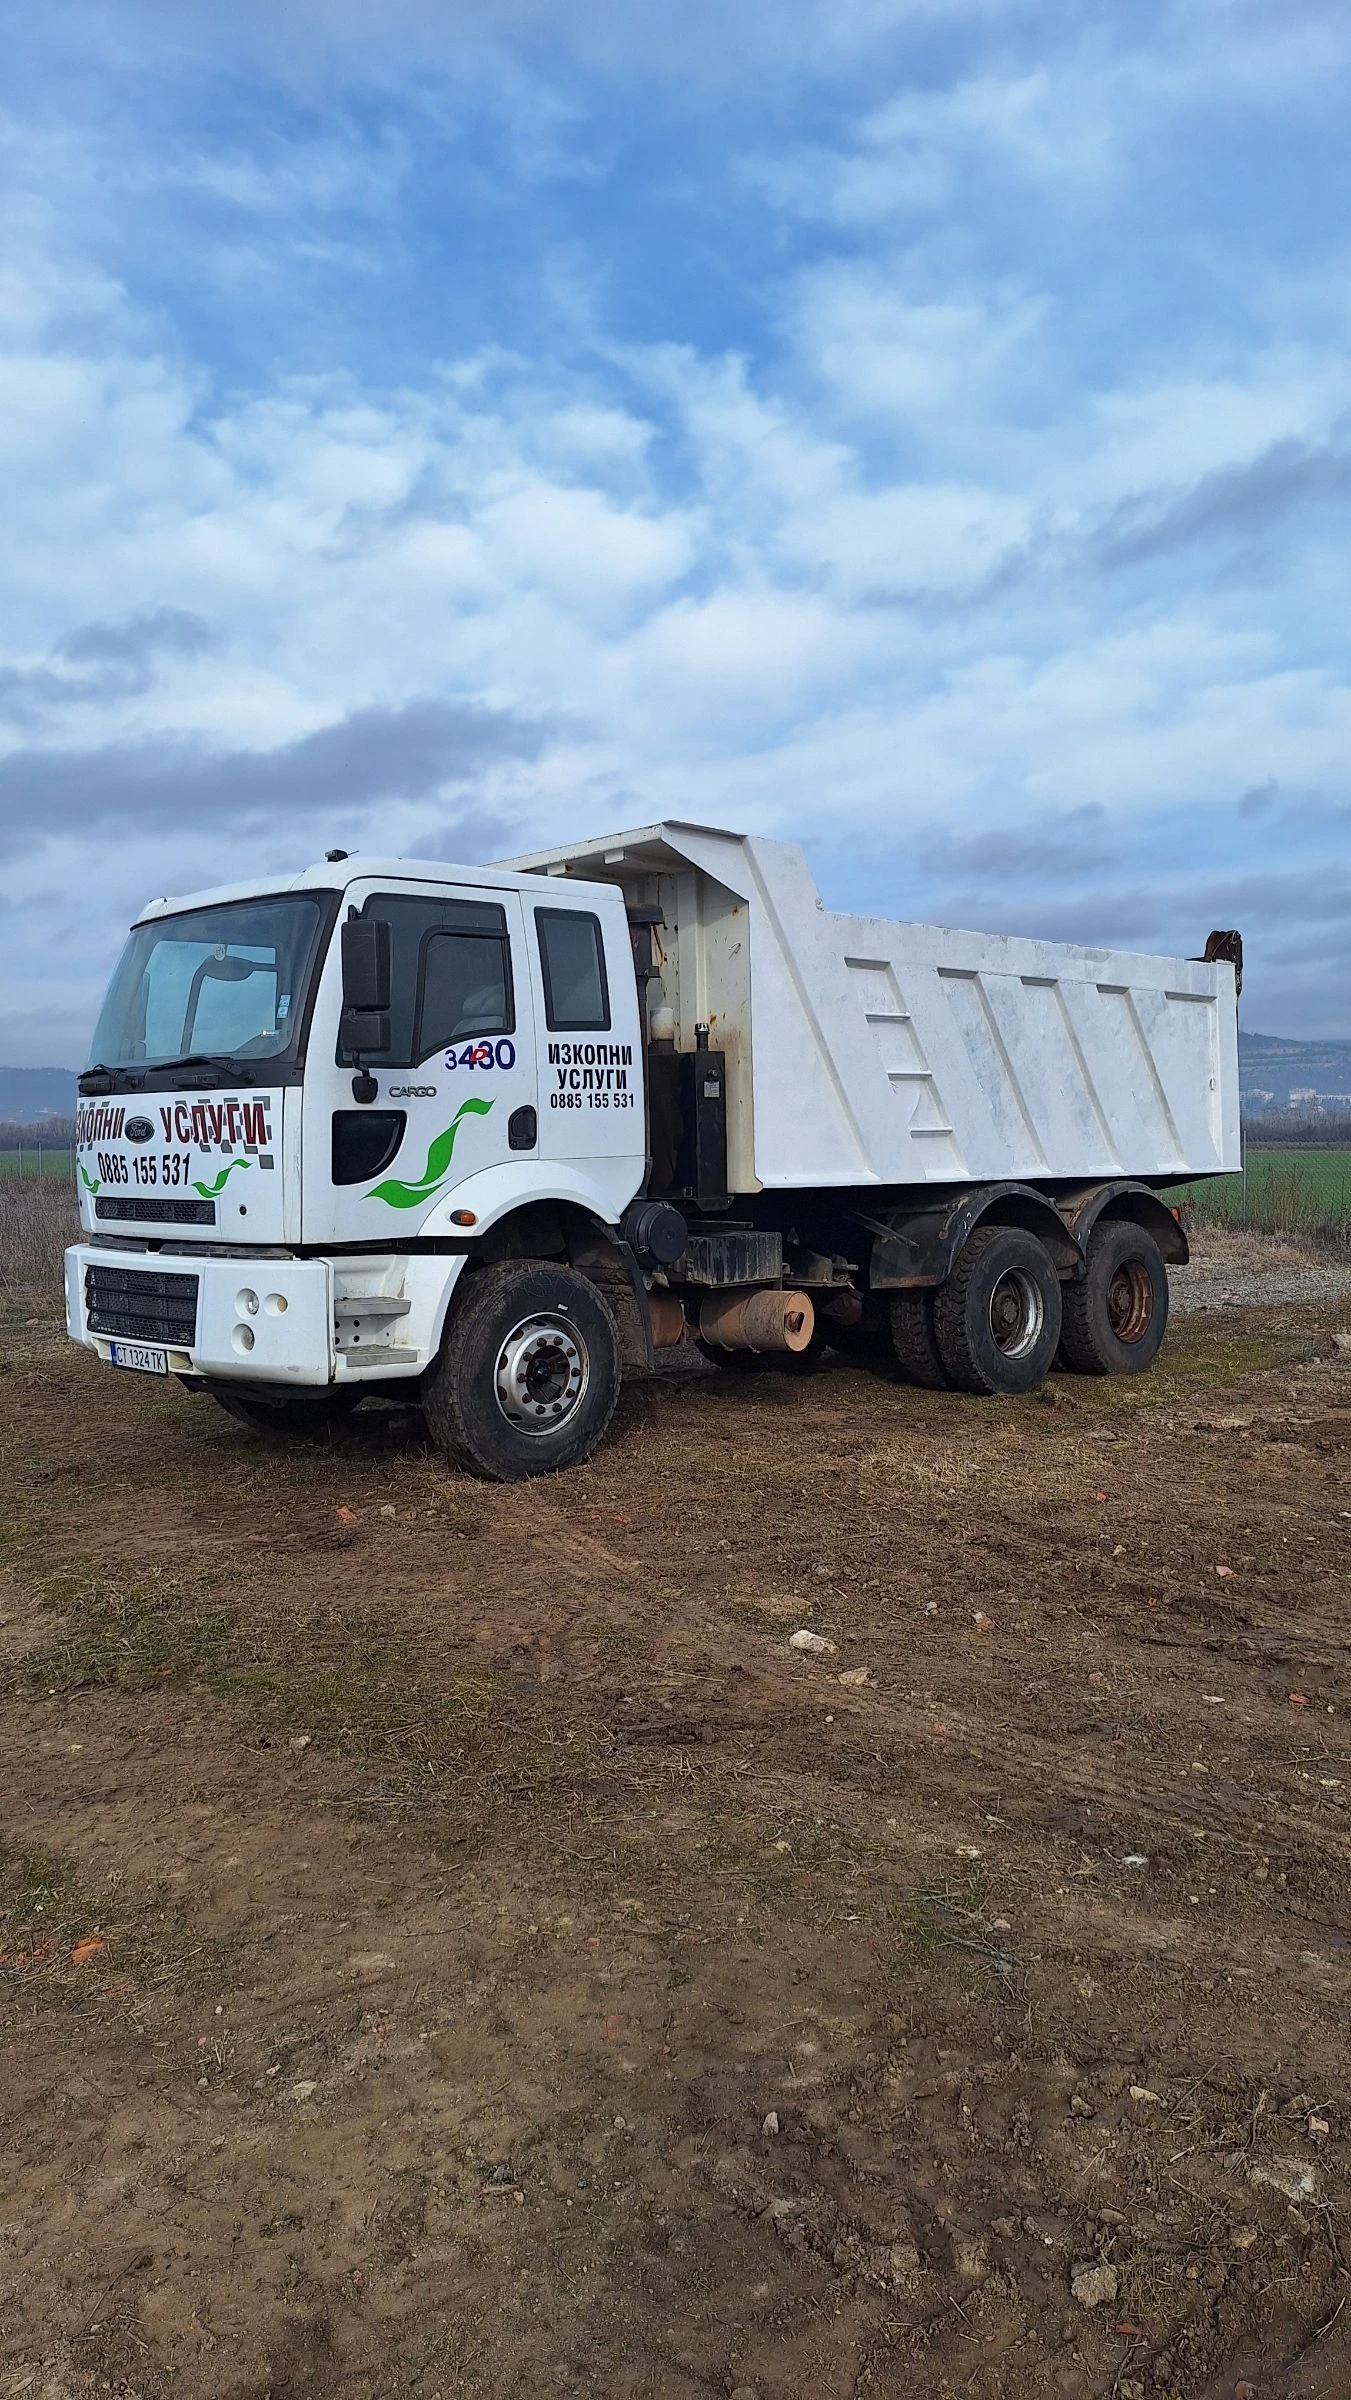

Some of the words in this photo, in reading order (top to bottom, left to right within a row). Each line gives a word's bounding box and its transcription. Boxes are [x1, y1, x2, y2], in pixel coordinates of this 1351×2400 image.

[548, 1043, 633, 1065] ИЗКОПНИ
[557, 1068, 627, 1090] УСЛУГИ
[389, 1086, 437, 1097] CARGO
[550, 1093, 582, 1108] 0885
[587, 1093, 609, 1108] 155
[613, 1093, 634, 1108] 531
[130, 1122, 147, 1137] Ford
[160, 1103, 268, 1145] УСЛУГИ
[97, 1152, 129, 1184] 0885
[132, 1156, 157, 1185] 155
[162, 1152, 191, 1185] 531
[117, 1346, 126, 1364] CT
[130, 1349, 149, 1368] 1324
[151, 1352, 163, 1370] TK
